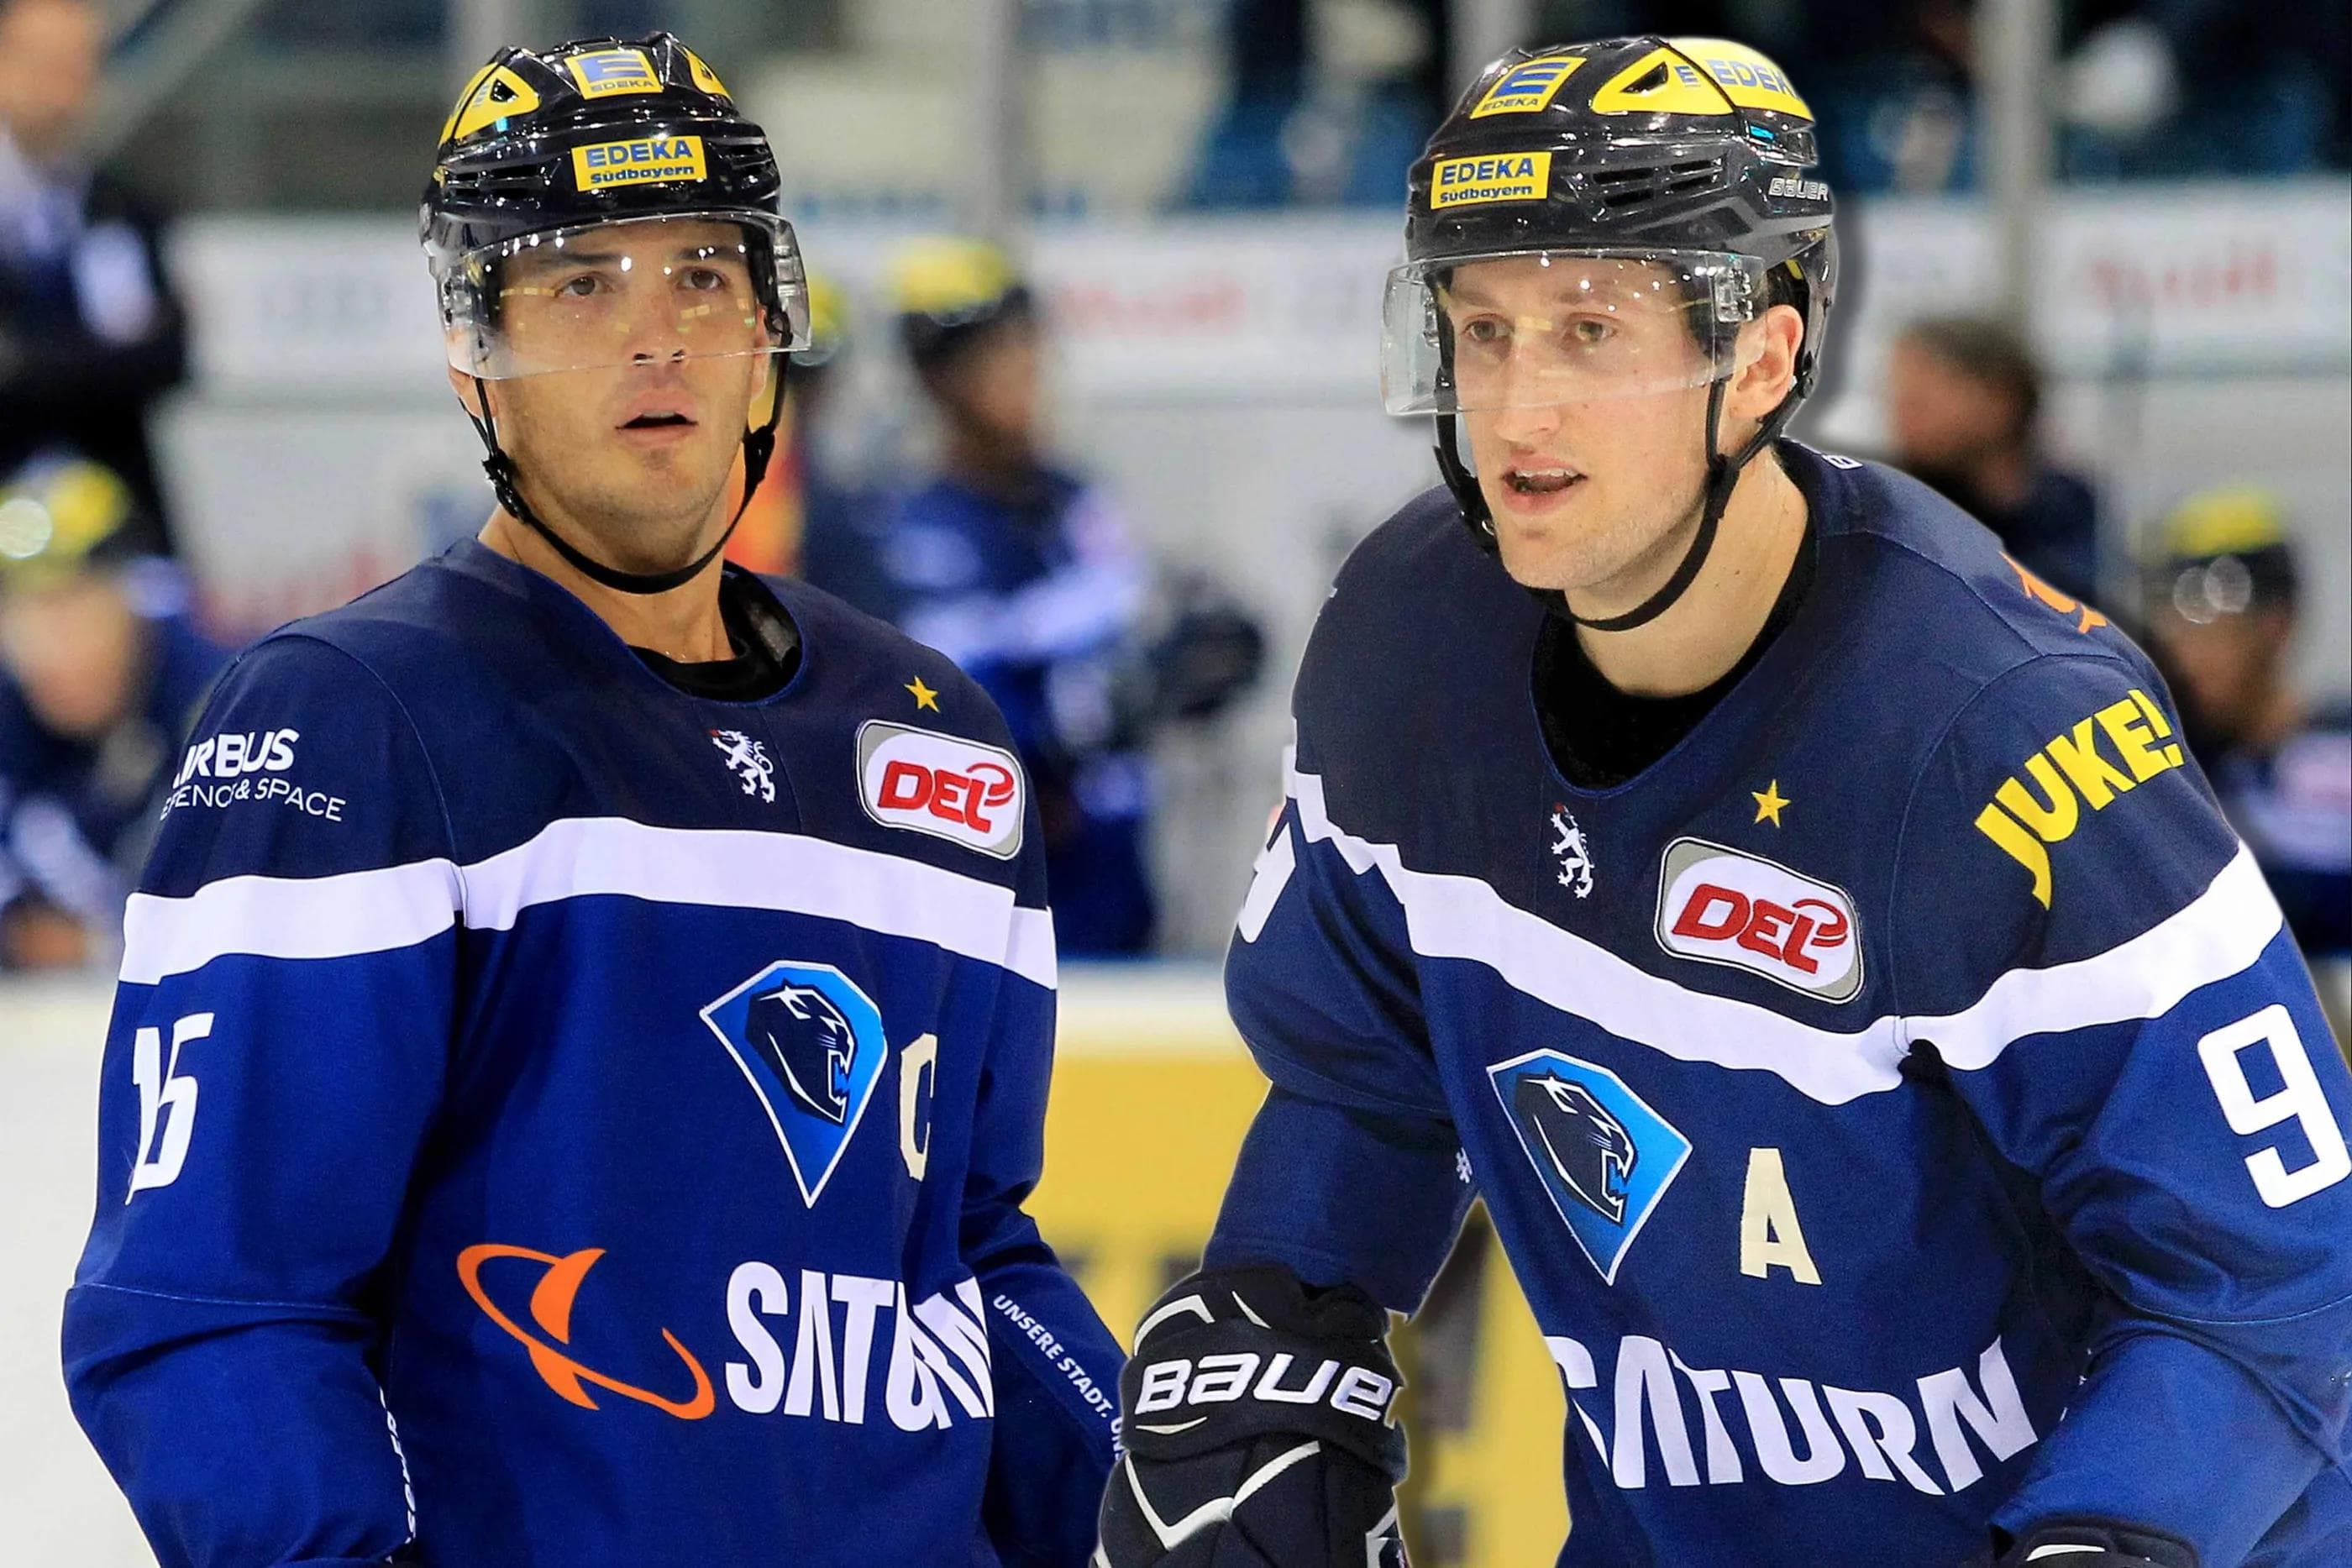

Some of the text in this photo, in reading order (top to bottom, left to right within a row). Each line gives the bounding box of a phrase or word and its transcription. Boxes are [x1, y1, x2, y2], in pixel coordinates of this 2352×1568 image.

[591, 81, 654, 92] EDEKA
[1481, 98, 1539, 111] EDEKA
[585, 140, 693, 167] EDEKA
[591, 166, 694, 184] Südbayern
[1441, 158, 1534, 186] EDEKA
[255, 778, 347, 822] SPACE
[878, 760, 1016, 834] DEL
[1975, 690, 2184, 910] JUKE!
[1672, 883, 1849, 974] DEL
[2197, 1004, 2352, 1209] 9
[1740, 1147, 1823, 1286] A
[992, 1294, 1065, 1360] UNSERE
[1057, 1357, 1114, 1419] STADT.
